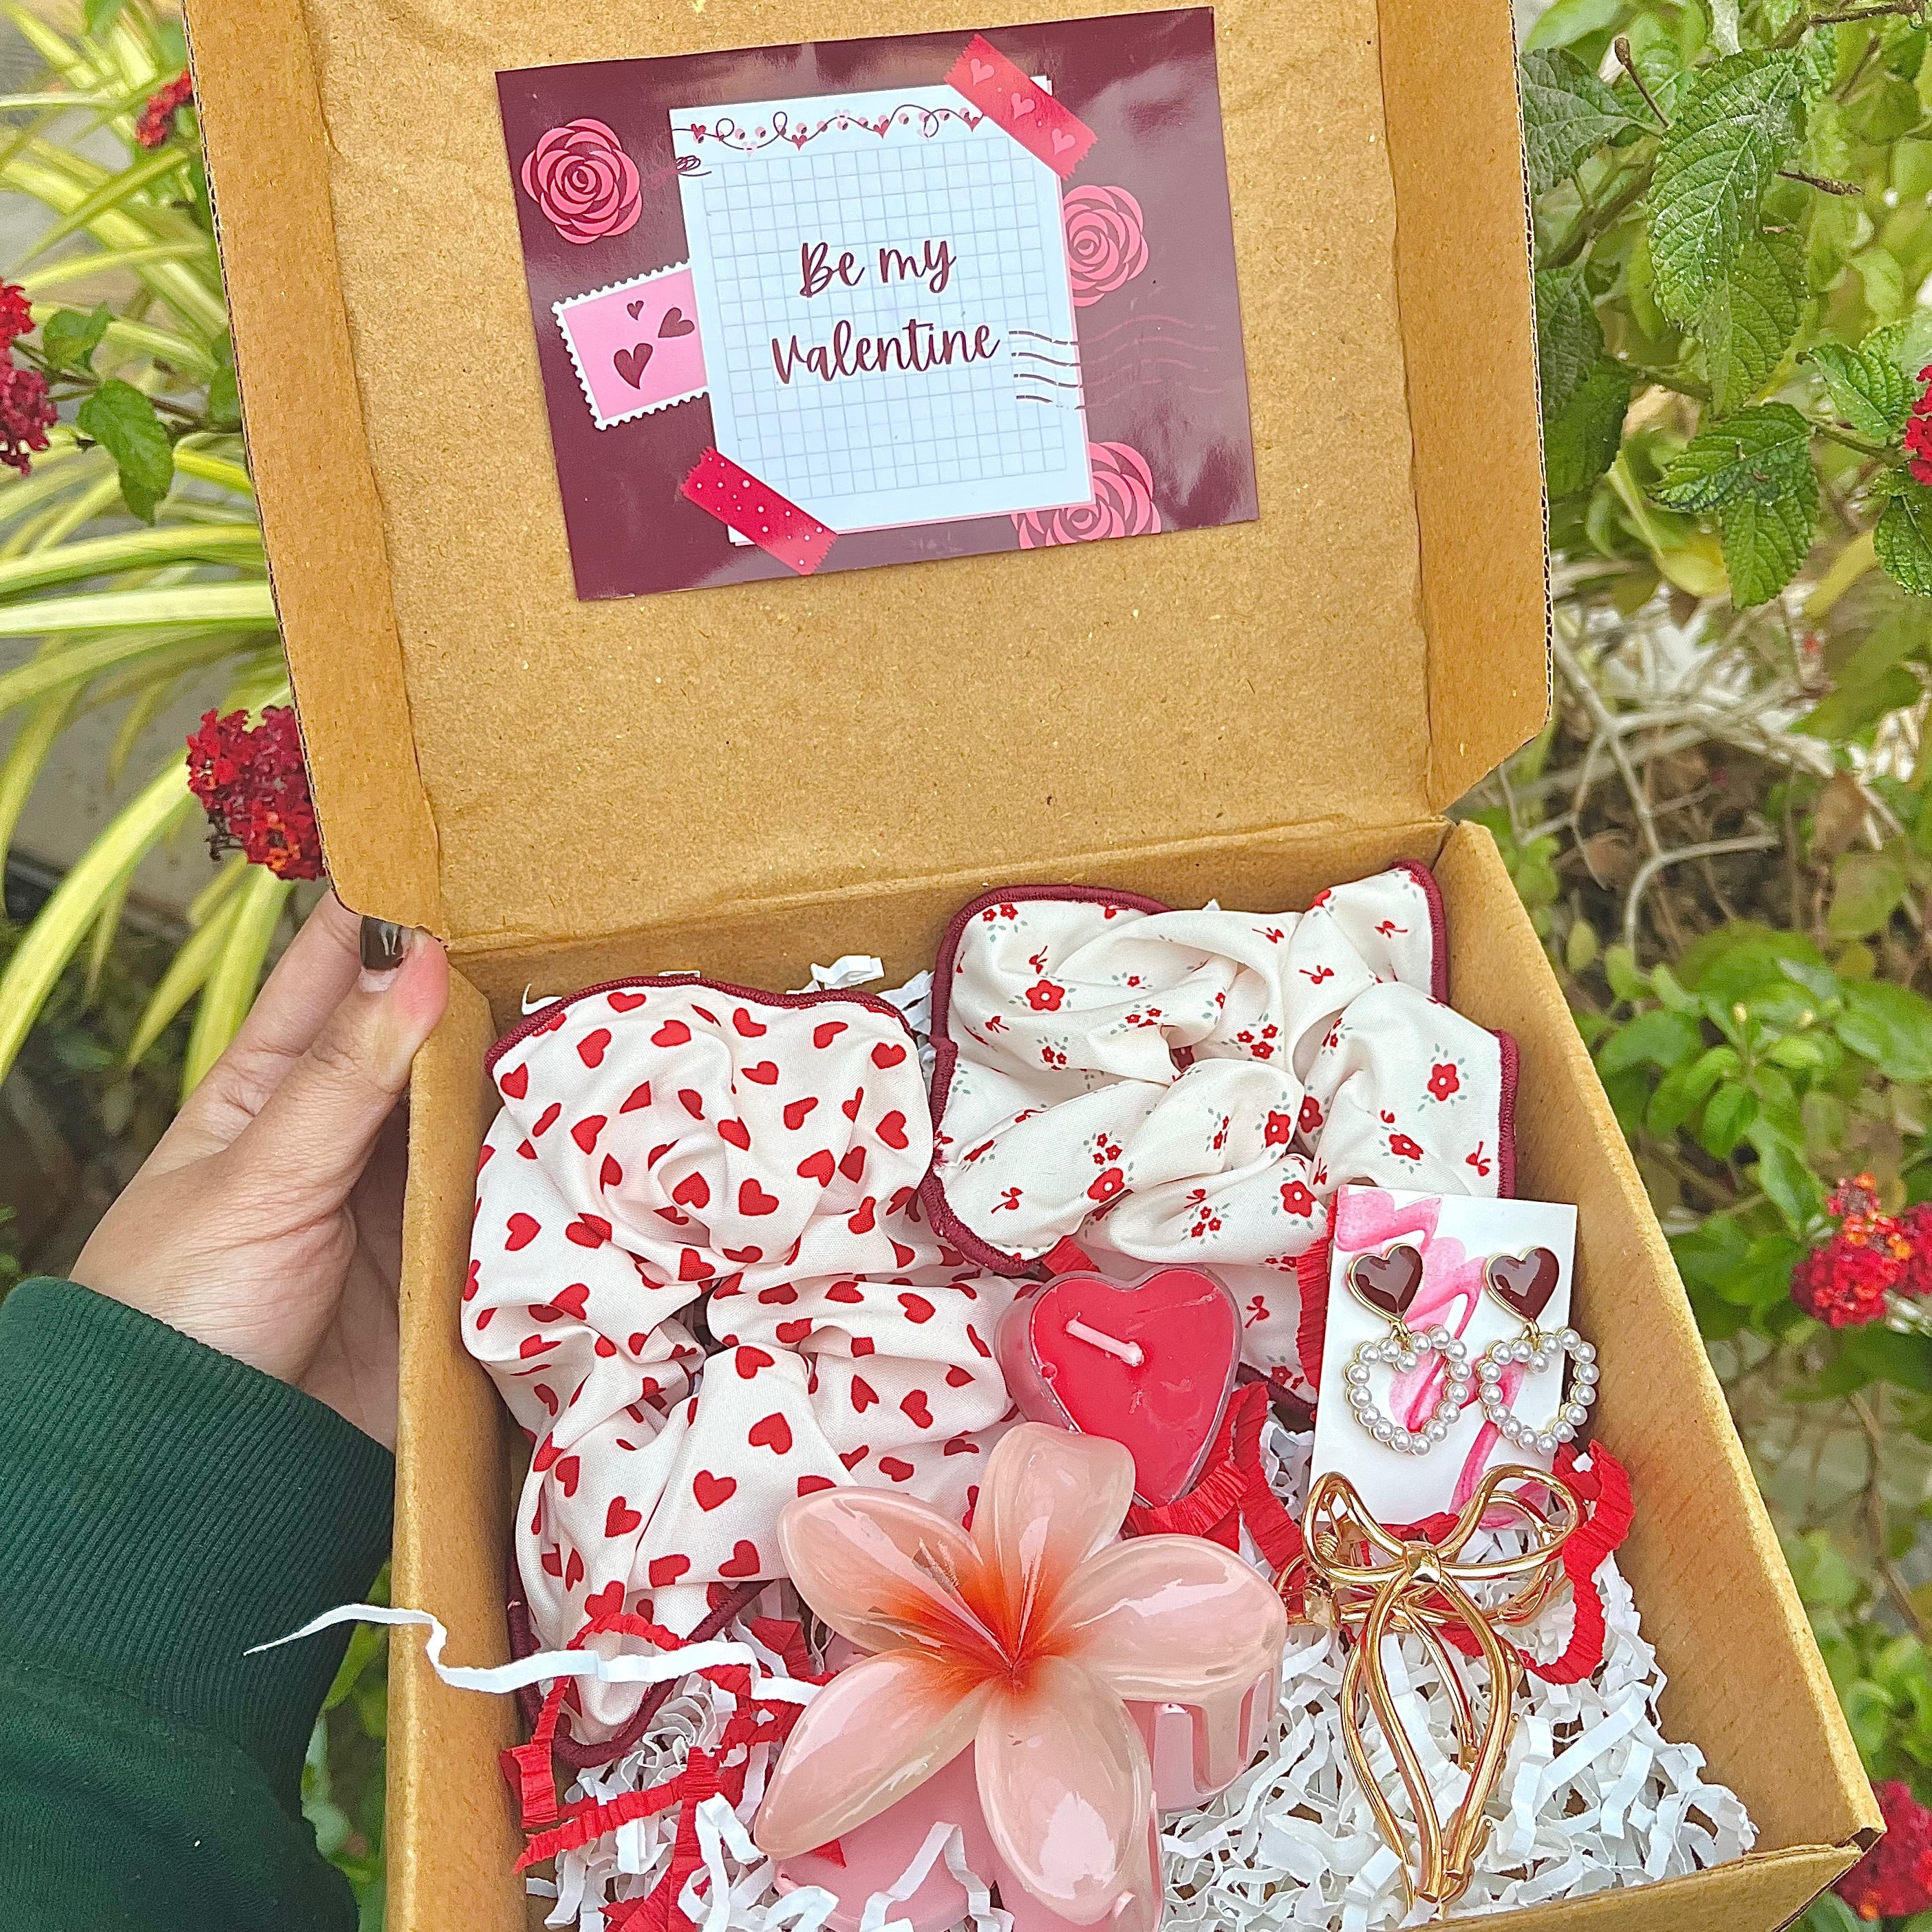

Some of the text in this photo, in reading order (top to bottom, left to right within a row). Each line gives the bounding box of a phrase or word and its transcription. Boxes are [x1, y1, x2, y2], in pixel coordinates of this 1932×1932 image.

[799, 239, 957, 298] Be my
[771, 319, 1000, 384] Valentine
